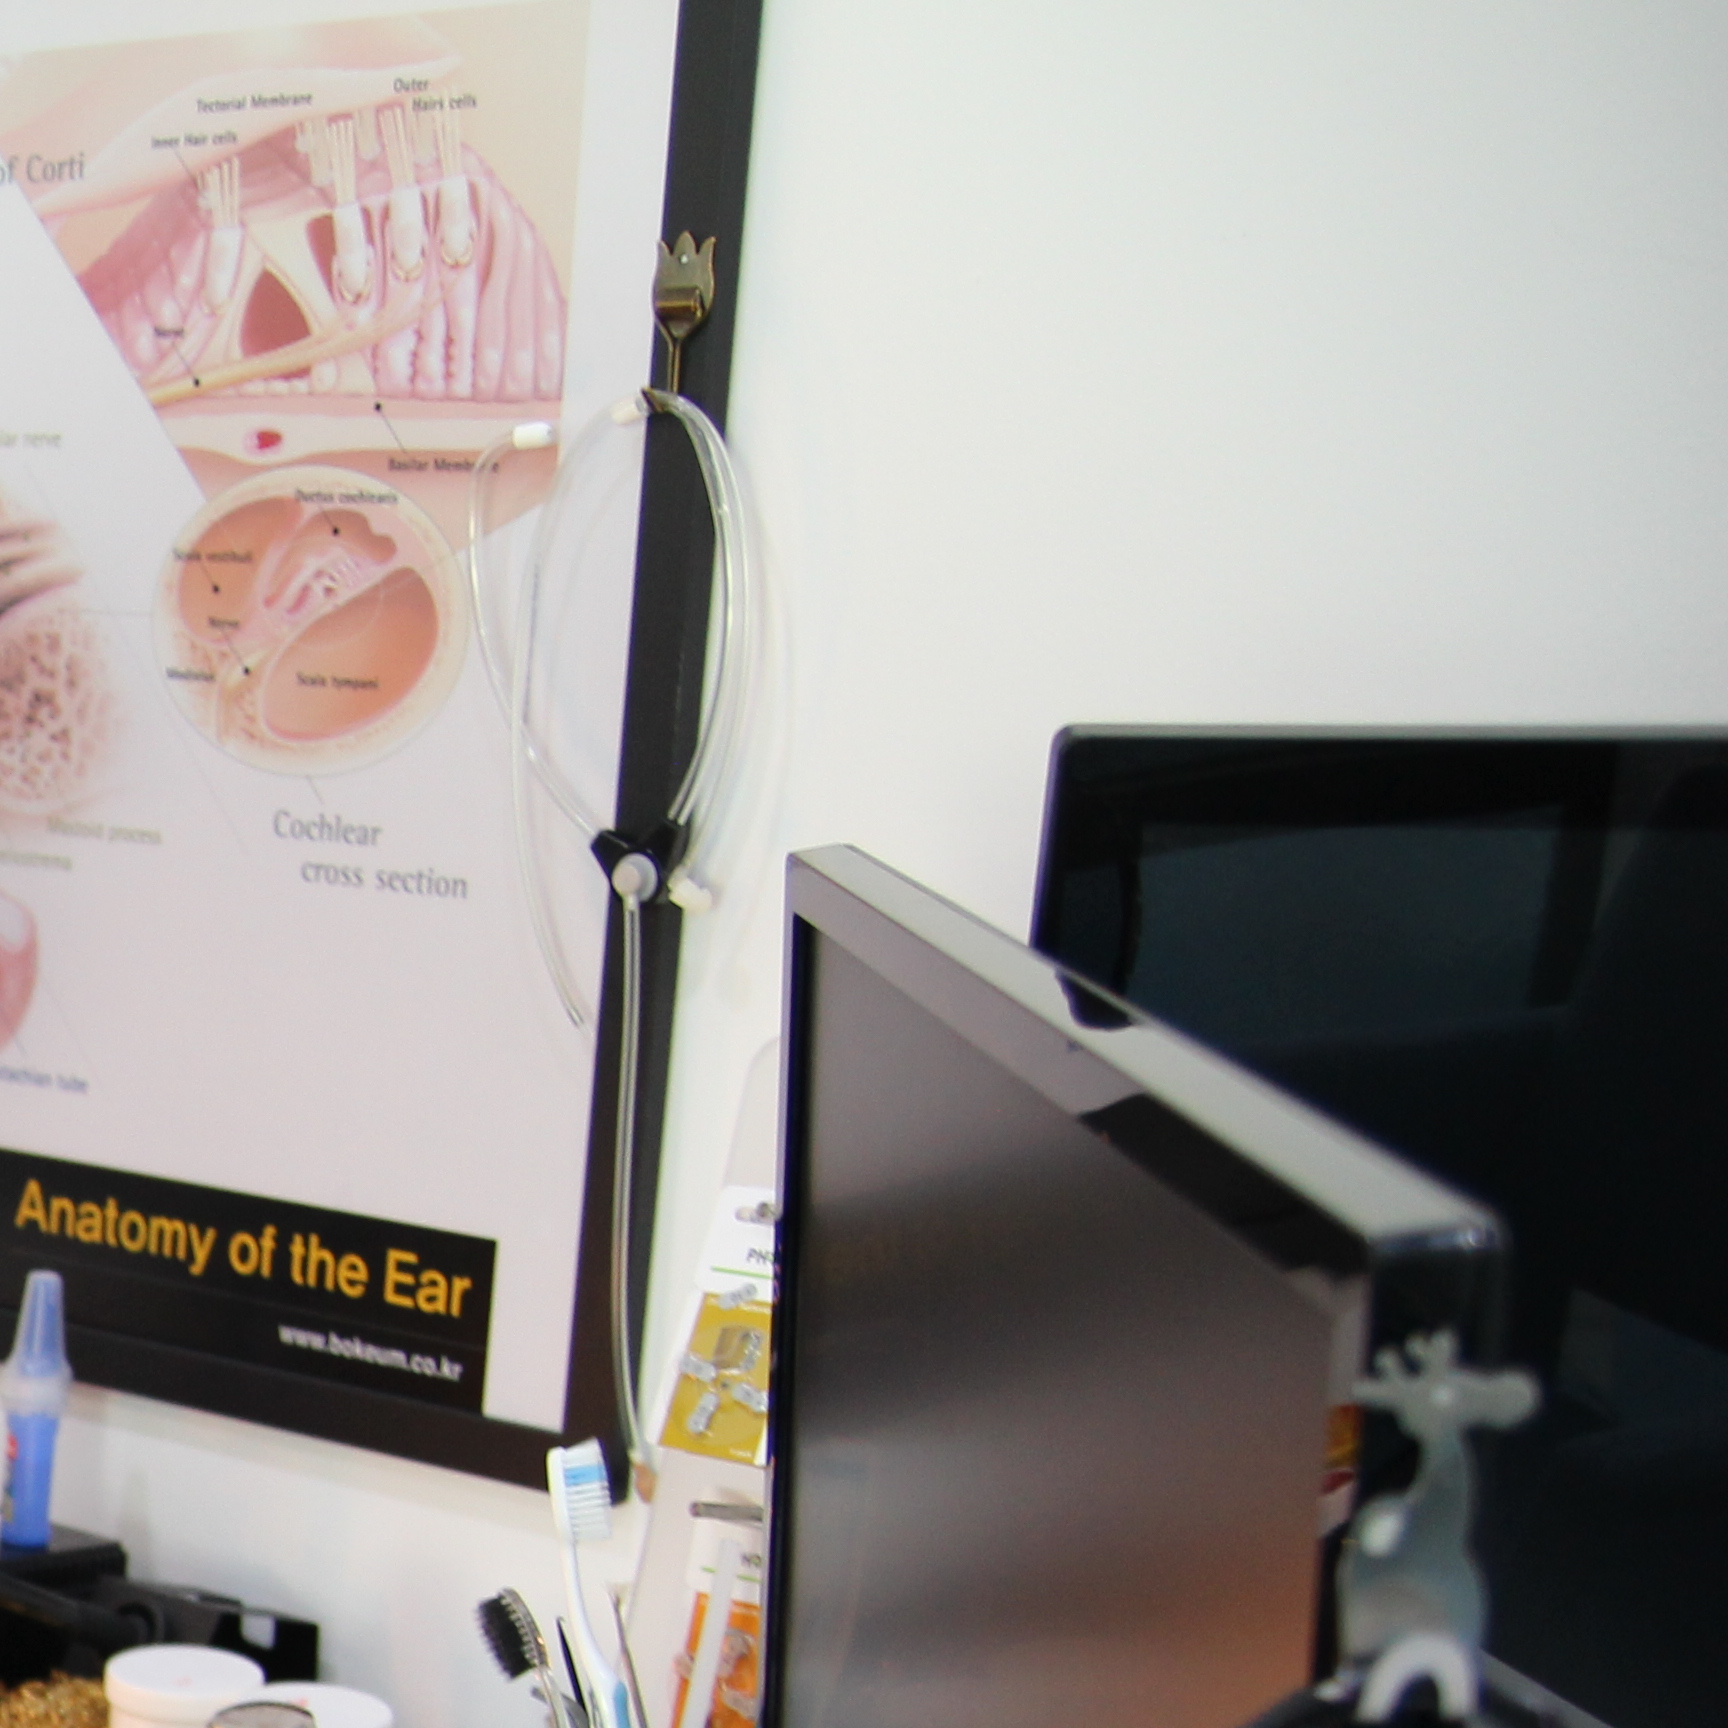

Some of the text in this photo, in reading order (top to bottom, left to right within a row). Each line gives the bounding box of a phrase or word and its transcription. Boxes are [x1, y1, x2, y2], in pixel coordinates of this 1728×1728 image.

[251, 93, 312, 109] Membrane
[393, 78, 429, 93] Outer
[151, 130, 237, 149] Inner Hair cells
[26, 153, 86, 183] Corti
[273, 808, 383, 848] Cochlear
[301, 858, 469, 900] cross section
[14, 1178, 473, 1319] Anatomy of the Ear
[276, 1322, 466, 1383] www.bokeum.co.kr
